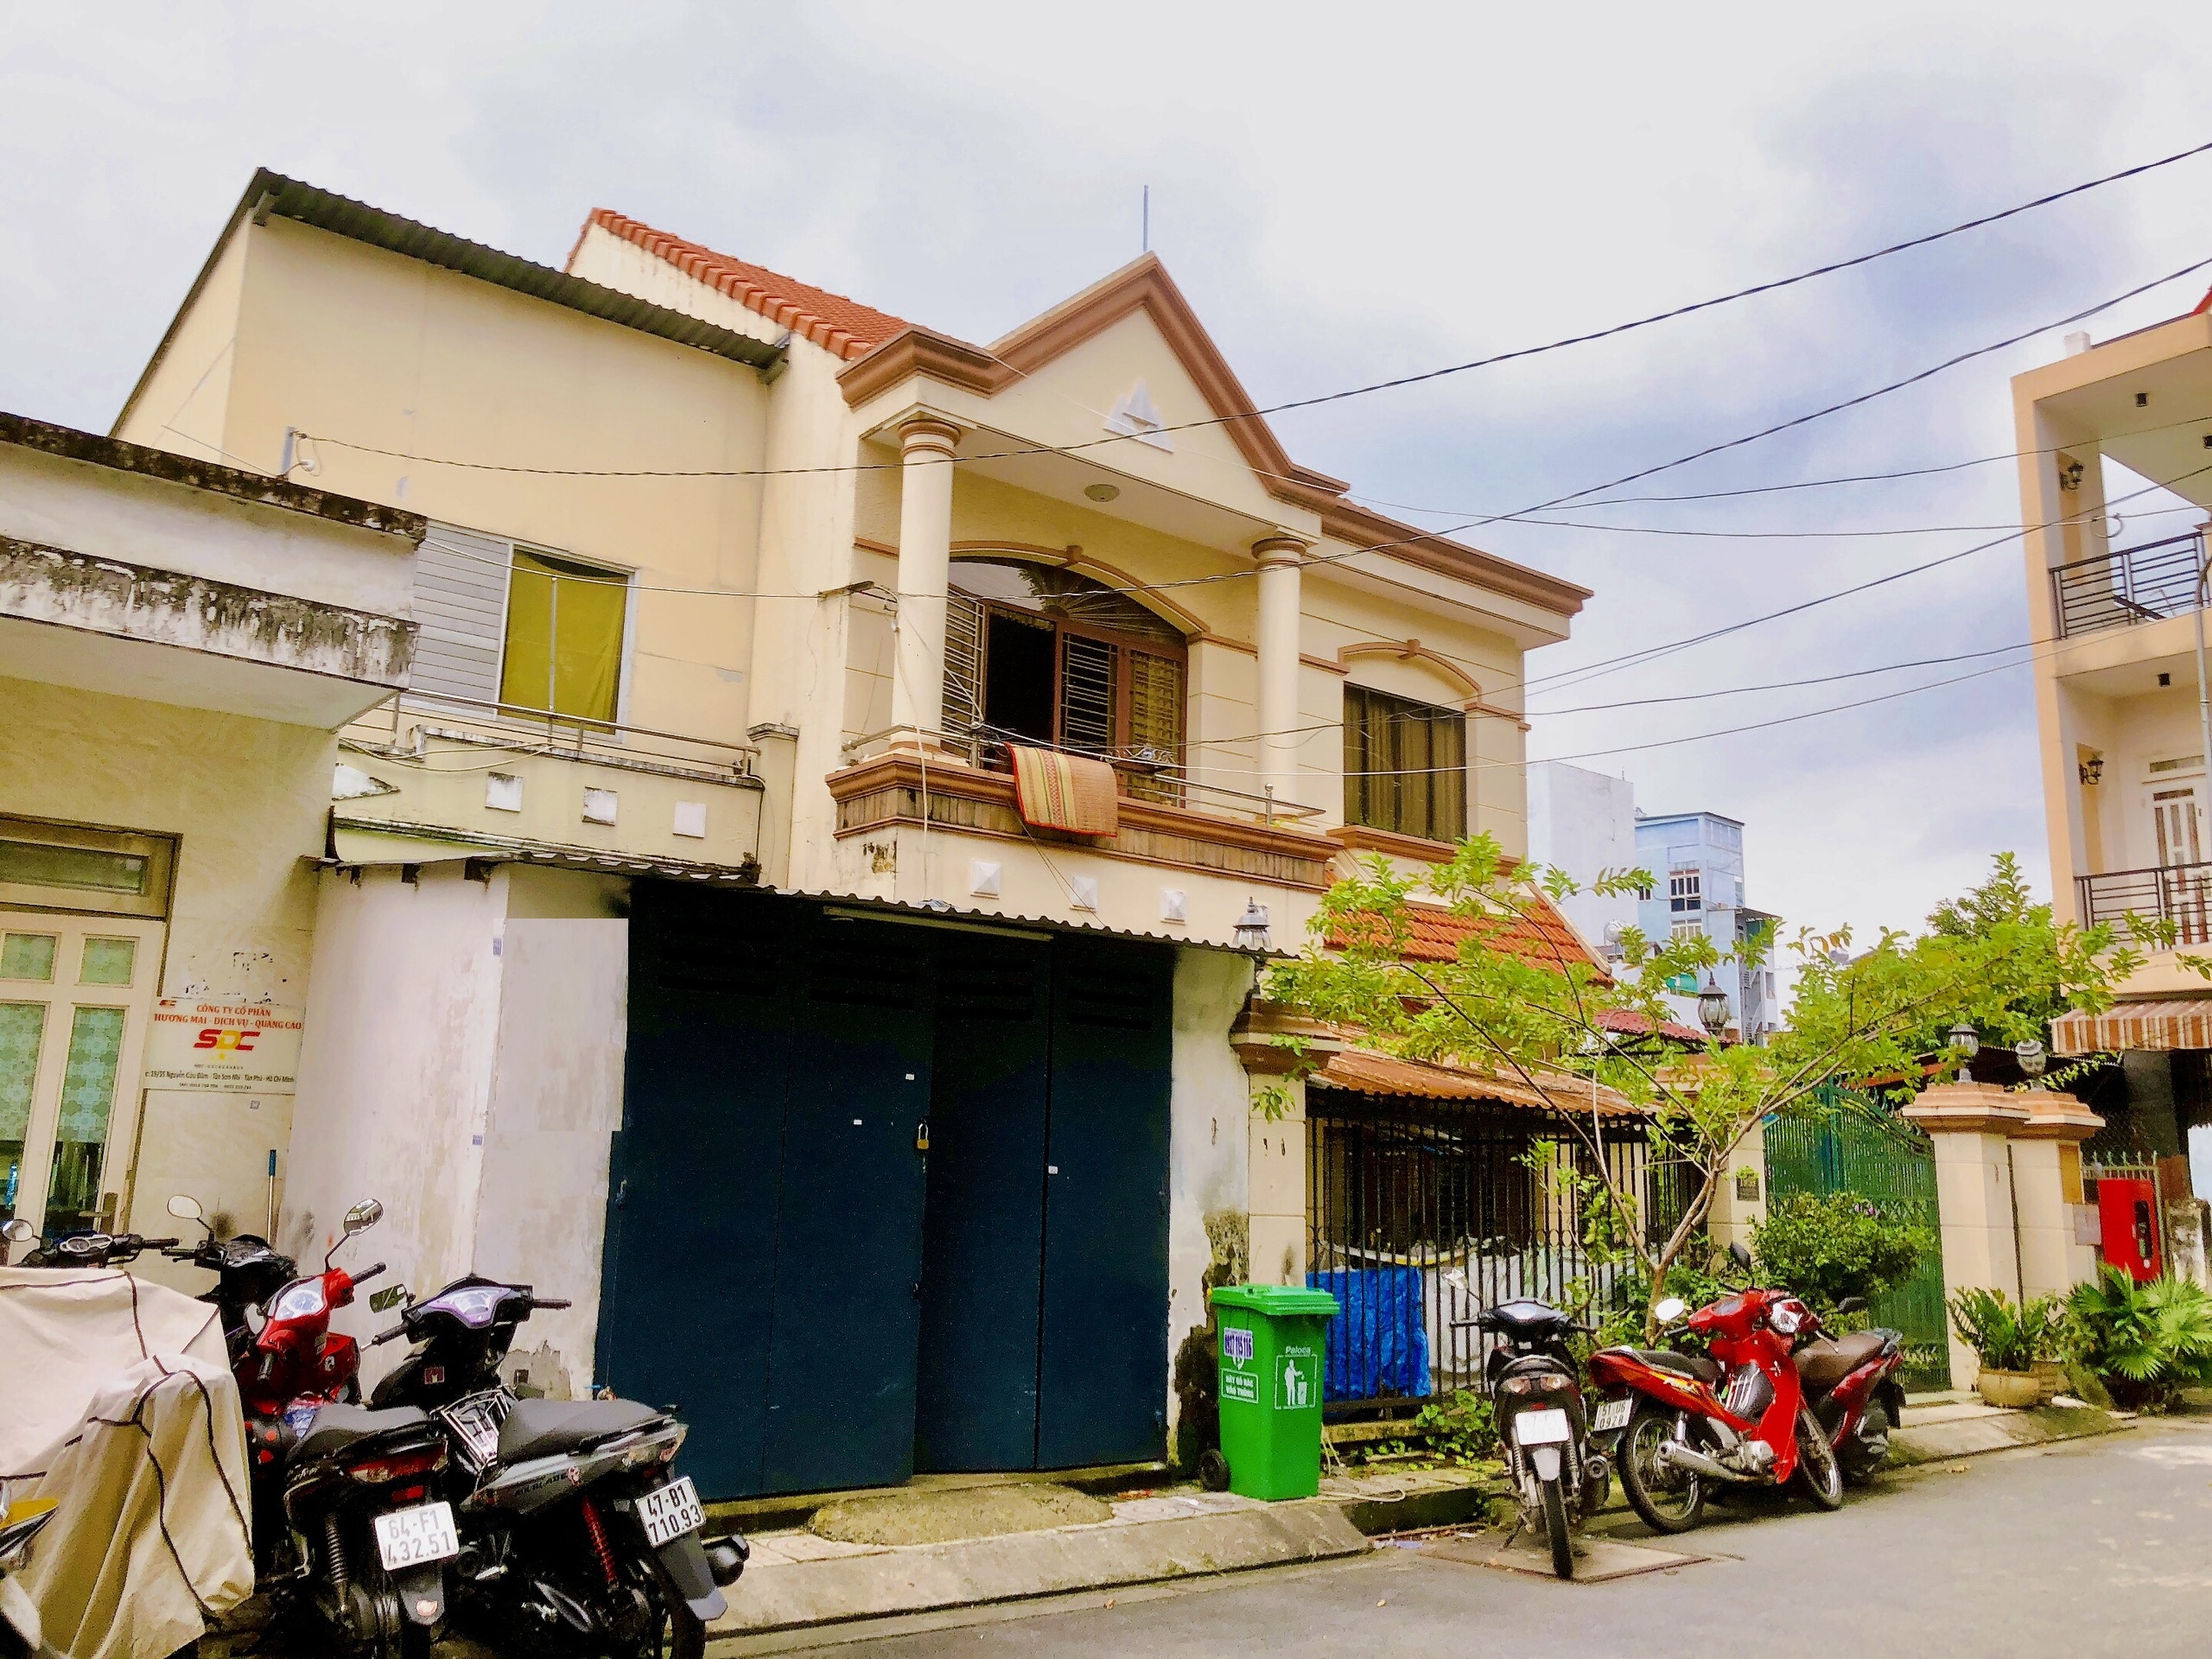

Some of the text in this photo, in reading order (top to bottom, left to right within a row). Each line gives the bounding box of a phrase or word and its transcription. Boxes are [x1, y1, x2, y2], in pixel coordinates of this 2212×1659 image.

[223, 1006, 232, 1014] TY
[193, 1028, 261, 1052] SDC
[387, 1509, 440, 1540] 64-F1
